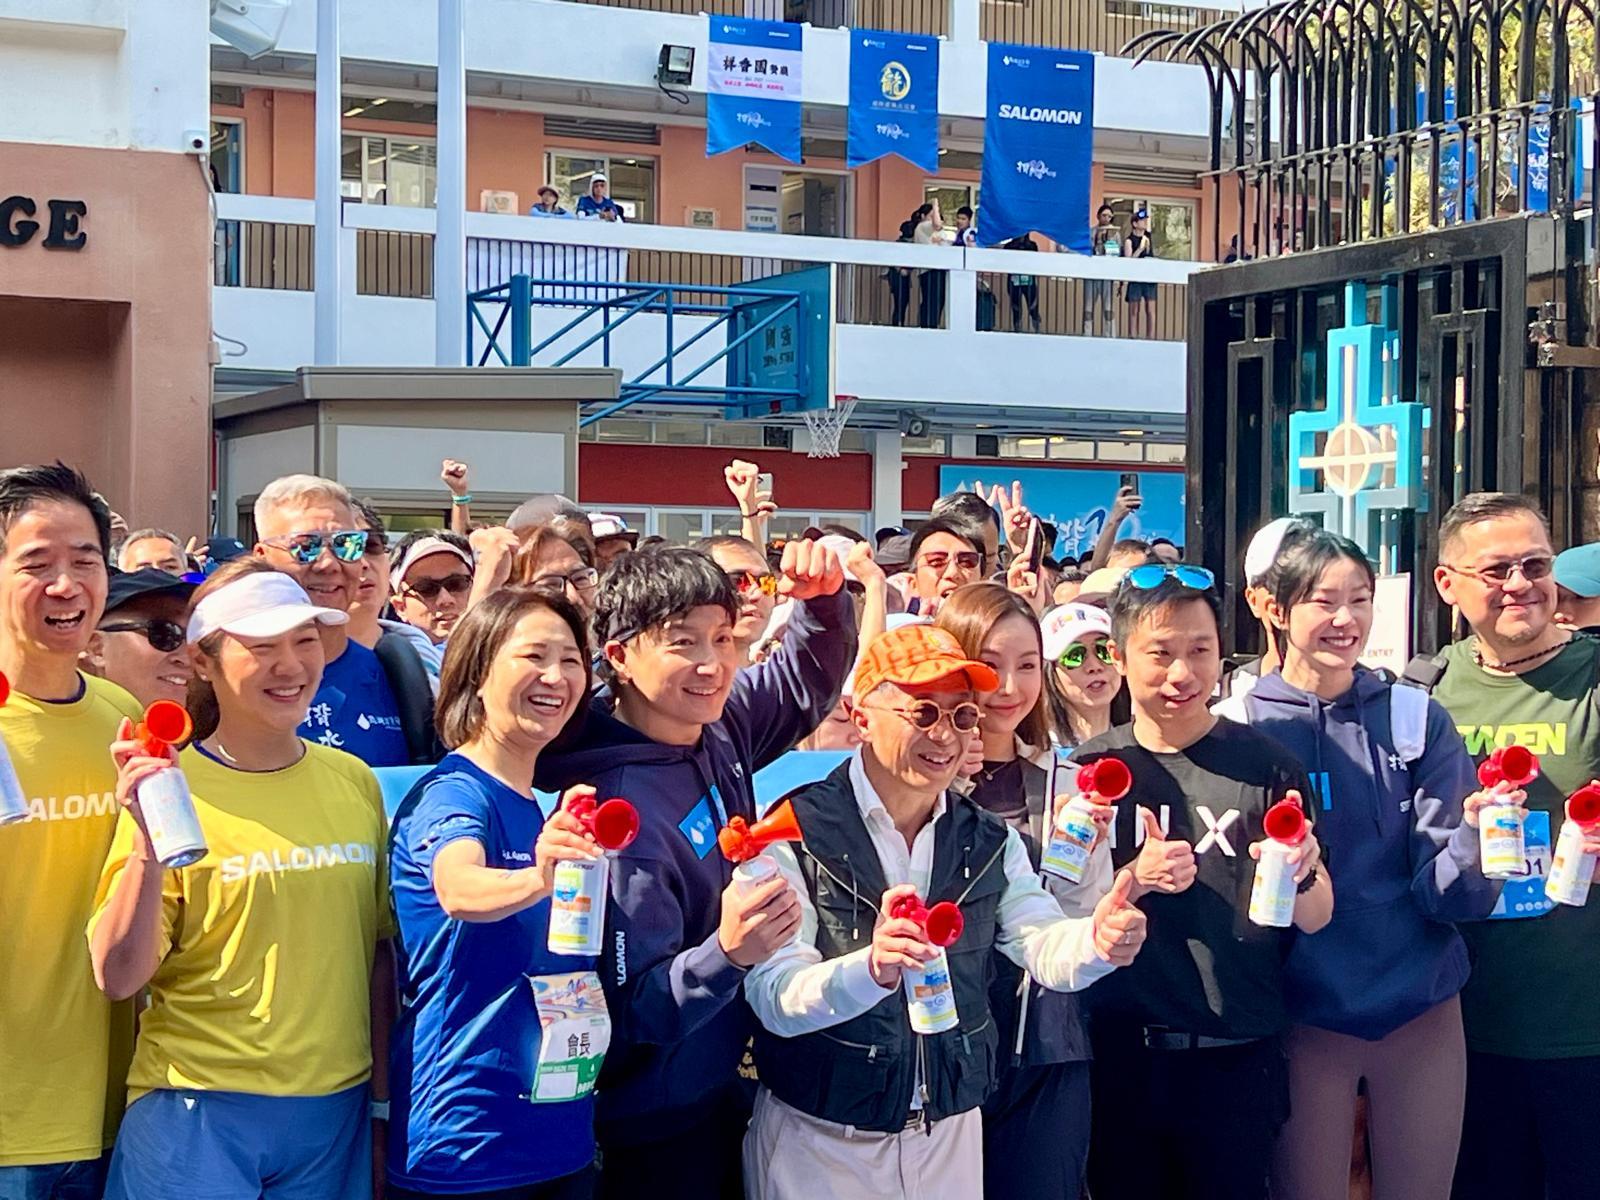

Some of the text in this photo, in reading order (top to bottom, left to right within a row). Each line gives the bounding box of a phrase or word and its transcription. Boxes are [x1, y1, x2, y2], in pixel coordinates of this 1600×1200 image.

[998, 104, 1083, 126] SALOMON
[1367, 649, 1394, 658] ENTRY
[22, 791, 117, 824] ALOM
[567, 1031, 591, 1058] 會長
